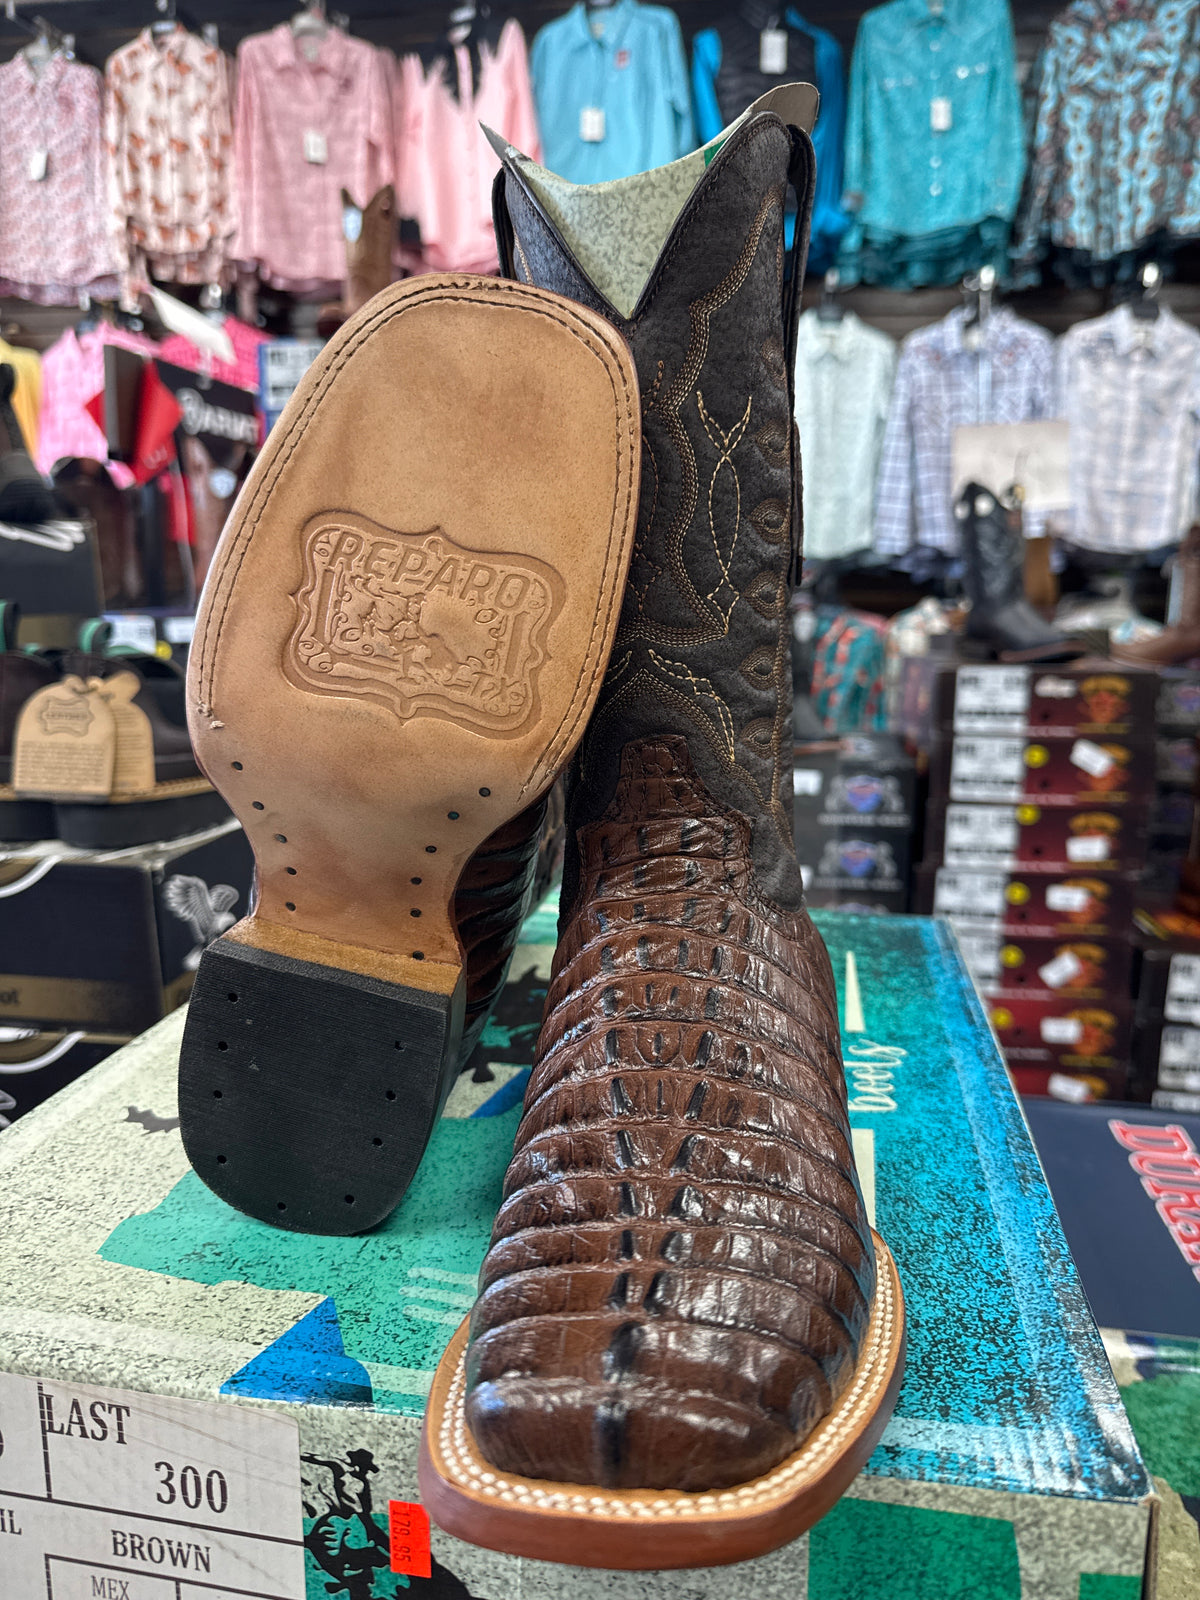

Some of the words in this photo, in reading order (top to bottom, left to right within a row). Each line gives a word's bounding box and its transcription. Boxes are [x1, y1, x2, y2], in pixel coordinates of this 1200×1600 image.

[327, 529, 531, 611] REPARO
[43, 1393, 131, 1445] LAST
[153, 1461, 229, 1514] 300
[110, 1529, 211, 1573] BROWN
[392, 1510, 411, 1562] 179.95
[91, 1575, 130, 1600] MEX
